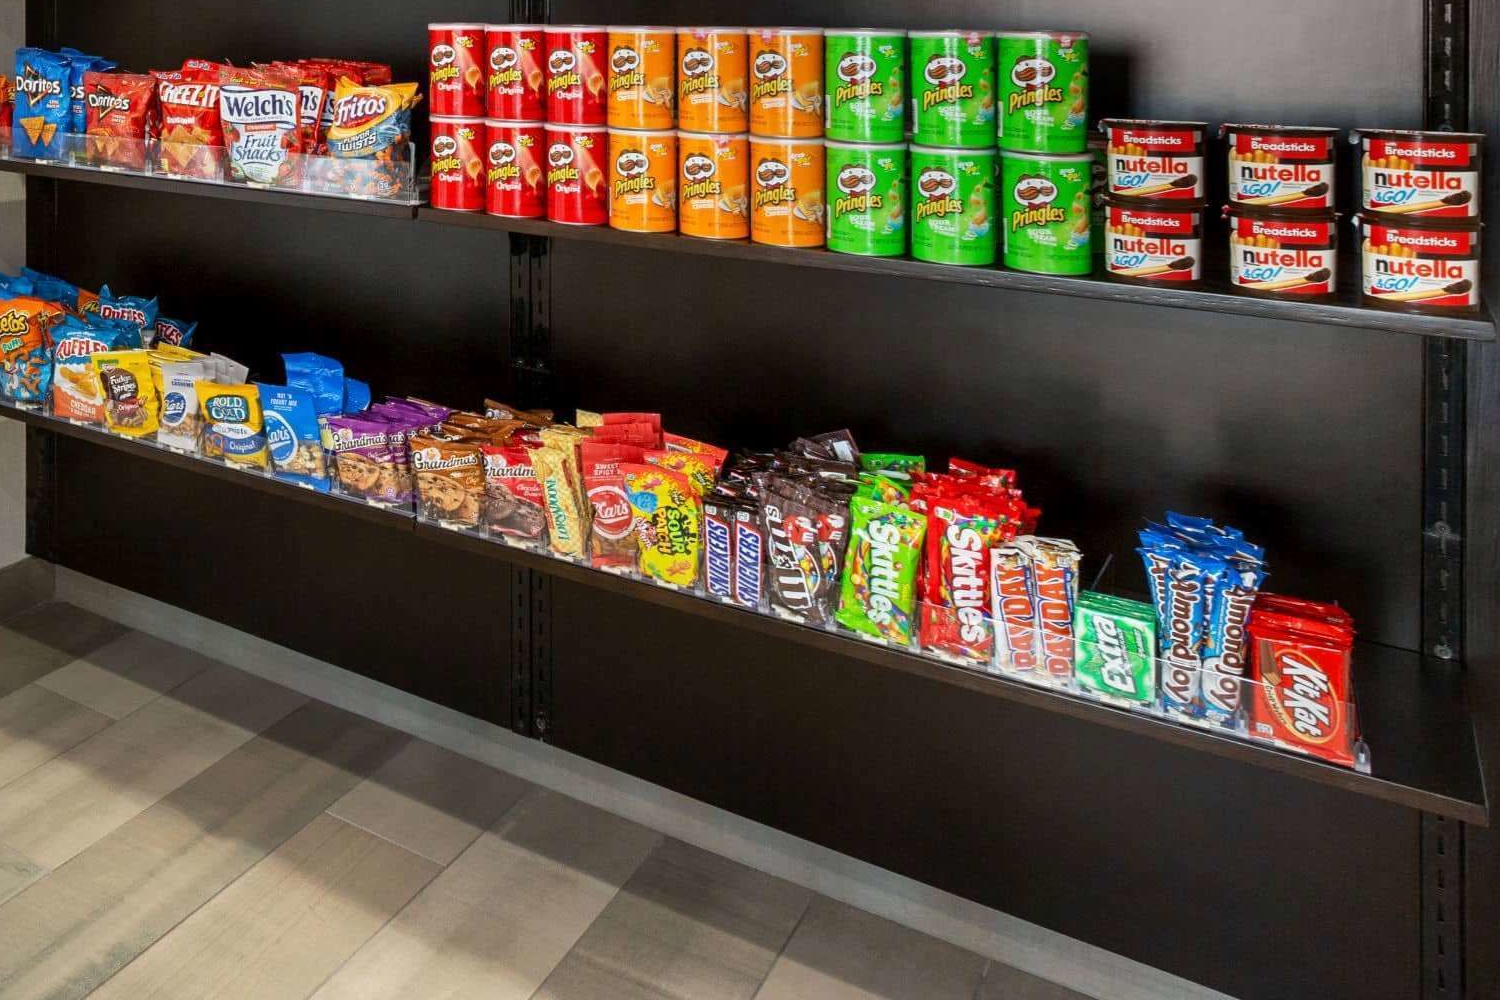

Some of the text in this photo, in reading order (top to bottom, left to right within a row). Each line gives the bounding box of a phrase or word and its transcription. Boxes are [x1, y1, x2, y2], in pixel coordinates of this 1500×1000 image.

[16, 76, 61, 93] Doritos
[753, 78, 792, 98] Pringles
[835, 81, 882, 107] Pringles
[89, 94, 130, 110] Doritos
[224, 92, 293, 117] Welch's
[923, 83, 973, 111] Pringles
[1009, 87, 1062, 113] Pringles
[336, 95, 386, 124] Fritos
[245, 134, 278, 149] Fruit
[336, 132, 377, 151] TWISTS
[1123, 135, 1182, 145] Breadsticks
[1250, 140, 1316, 153] Breadsticks
[234, 145, 281, 162] Snacks
[1385, 146, 1456, 158] Breadsticks
[1116, 157, 1188, 174] nutella
[1241, 163, 1321, 183] nutella
[1375, 172, 1462, 190] nutella
[835, 194, 882, 217] Pringles
[1012, 206, 1065, 231] Pringles
[1114, 237, 1185, 256] nutella
[1386, 234, 1457, 247] Breadsticks
[1376, 258, 1462, 278] nutella
[212, 397, 242, 408] ROLD
[211, 407, 246, 421] GOLD
[229, 441, 256, 450] Original
[332, 431, 387, 451] Grandma's
[412, 452, 477, 472] Grandma's
[656, 506, 672, 554] PATCH
[667, 508, 687, 554] SOUR
[707, 520, 730, 596] SNICKERS
[738, 526, 760, 608] SNICKERS
[868, 520, 901, 624] Skittles
[947, 524, 985, 643] Skittles
[997, 567, 1036, 670] PAYDAY
[1035, 567, 1071, 676] PAYDAY
